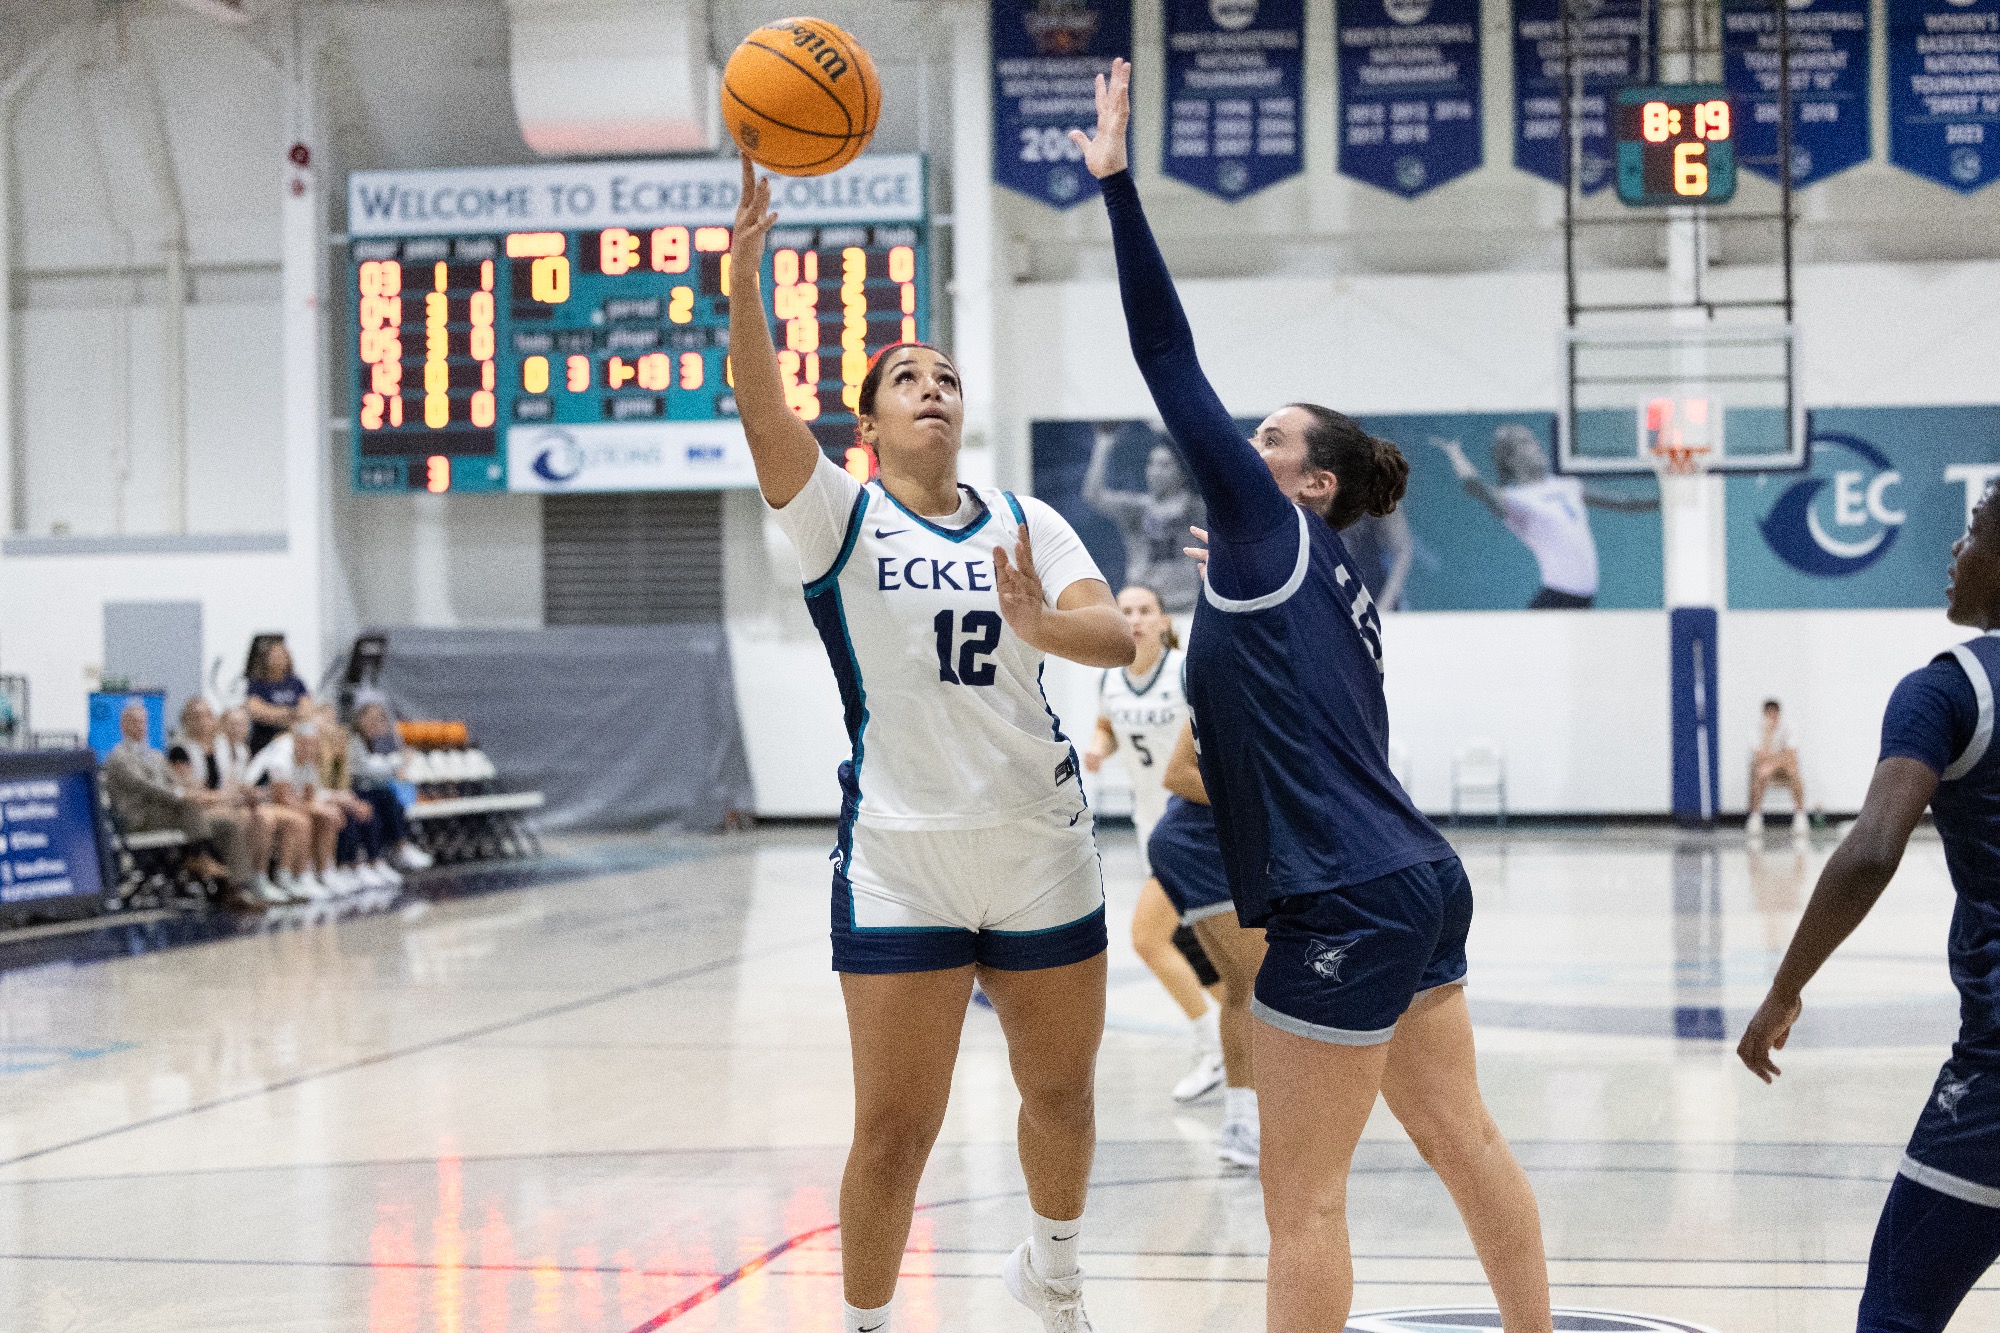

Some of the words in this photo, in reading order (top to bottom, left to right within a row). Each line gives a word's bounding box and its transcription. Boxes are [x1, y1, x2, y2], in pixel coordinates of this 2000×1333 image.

[1642, 100, 1731, 142] 8:19
[1020, 126, 1098, 162] 200
[1673, 141, 1708, 196] 6
[358, 183, 529, 220] WELCOME
[547, 183, 598, 217] TO
[610, 176, 739, 214] ECKERD
[600, 226, 690, 277] 8:19
[773, 248, 819, 286] 01
[888, 245, 916, 284] 0
[433, 260, 448, 293] 1
[480, 259, 495, 293] 1
[531, 256, 570, 304] 10
[469, 291, 495, 328] 0
[668, 285, 695, 325] 2
[900, 281, 916, 315] 1
[470, 326, 495, 361] 0
[481, 359, 496, 393] 1
[523, 355, 550, 394] 0
[566, 354, 591, 393] 3
[679, 351, 704, 391] 3
[360, 393, 404, 431] 21
[424, 394, 450, 430] 0
[470, 390, 496, 429] 0
[426, 455, 450, 493] 3
[1834, 469, 1907, 527] EC
[877, 556, 1000, 592] ECKE
[933, 609, 1003, 687] 12
[1129, 732, 1154, 768] 5
